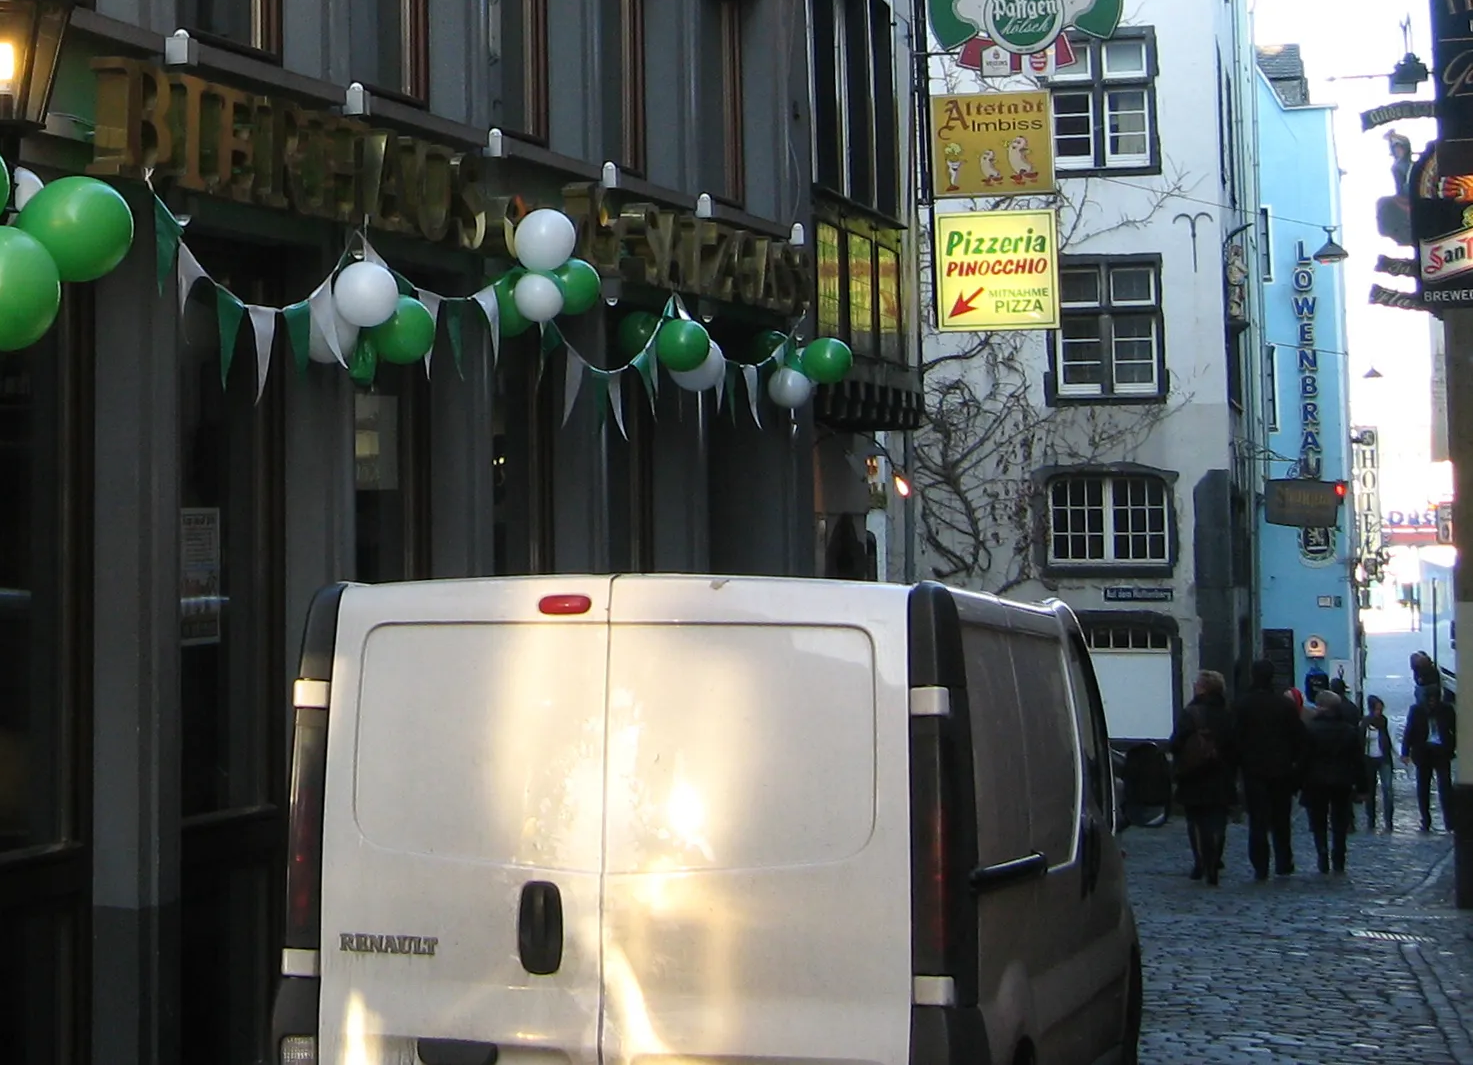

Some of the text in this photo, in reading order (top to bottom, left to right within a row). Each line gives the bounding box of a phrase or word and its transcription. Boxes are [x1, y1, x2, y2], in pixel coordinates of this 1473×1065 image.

[938, 98, 1044, 140] Altstadt
[971, 118, 1043, 133] Imbiss
[945, 228, 1046, 256] Pizzeria
[946, 258, 1048, 277] PINOCCHIO
[988, 287, 1049, 298] MITNAHME
[995, 299, 1044, 313] PIZZA
[1292, 239, 1321, 481] LÖWENBRÄU
[340, 933, 438, 955] RENAULT
